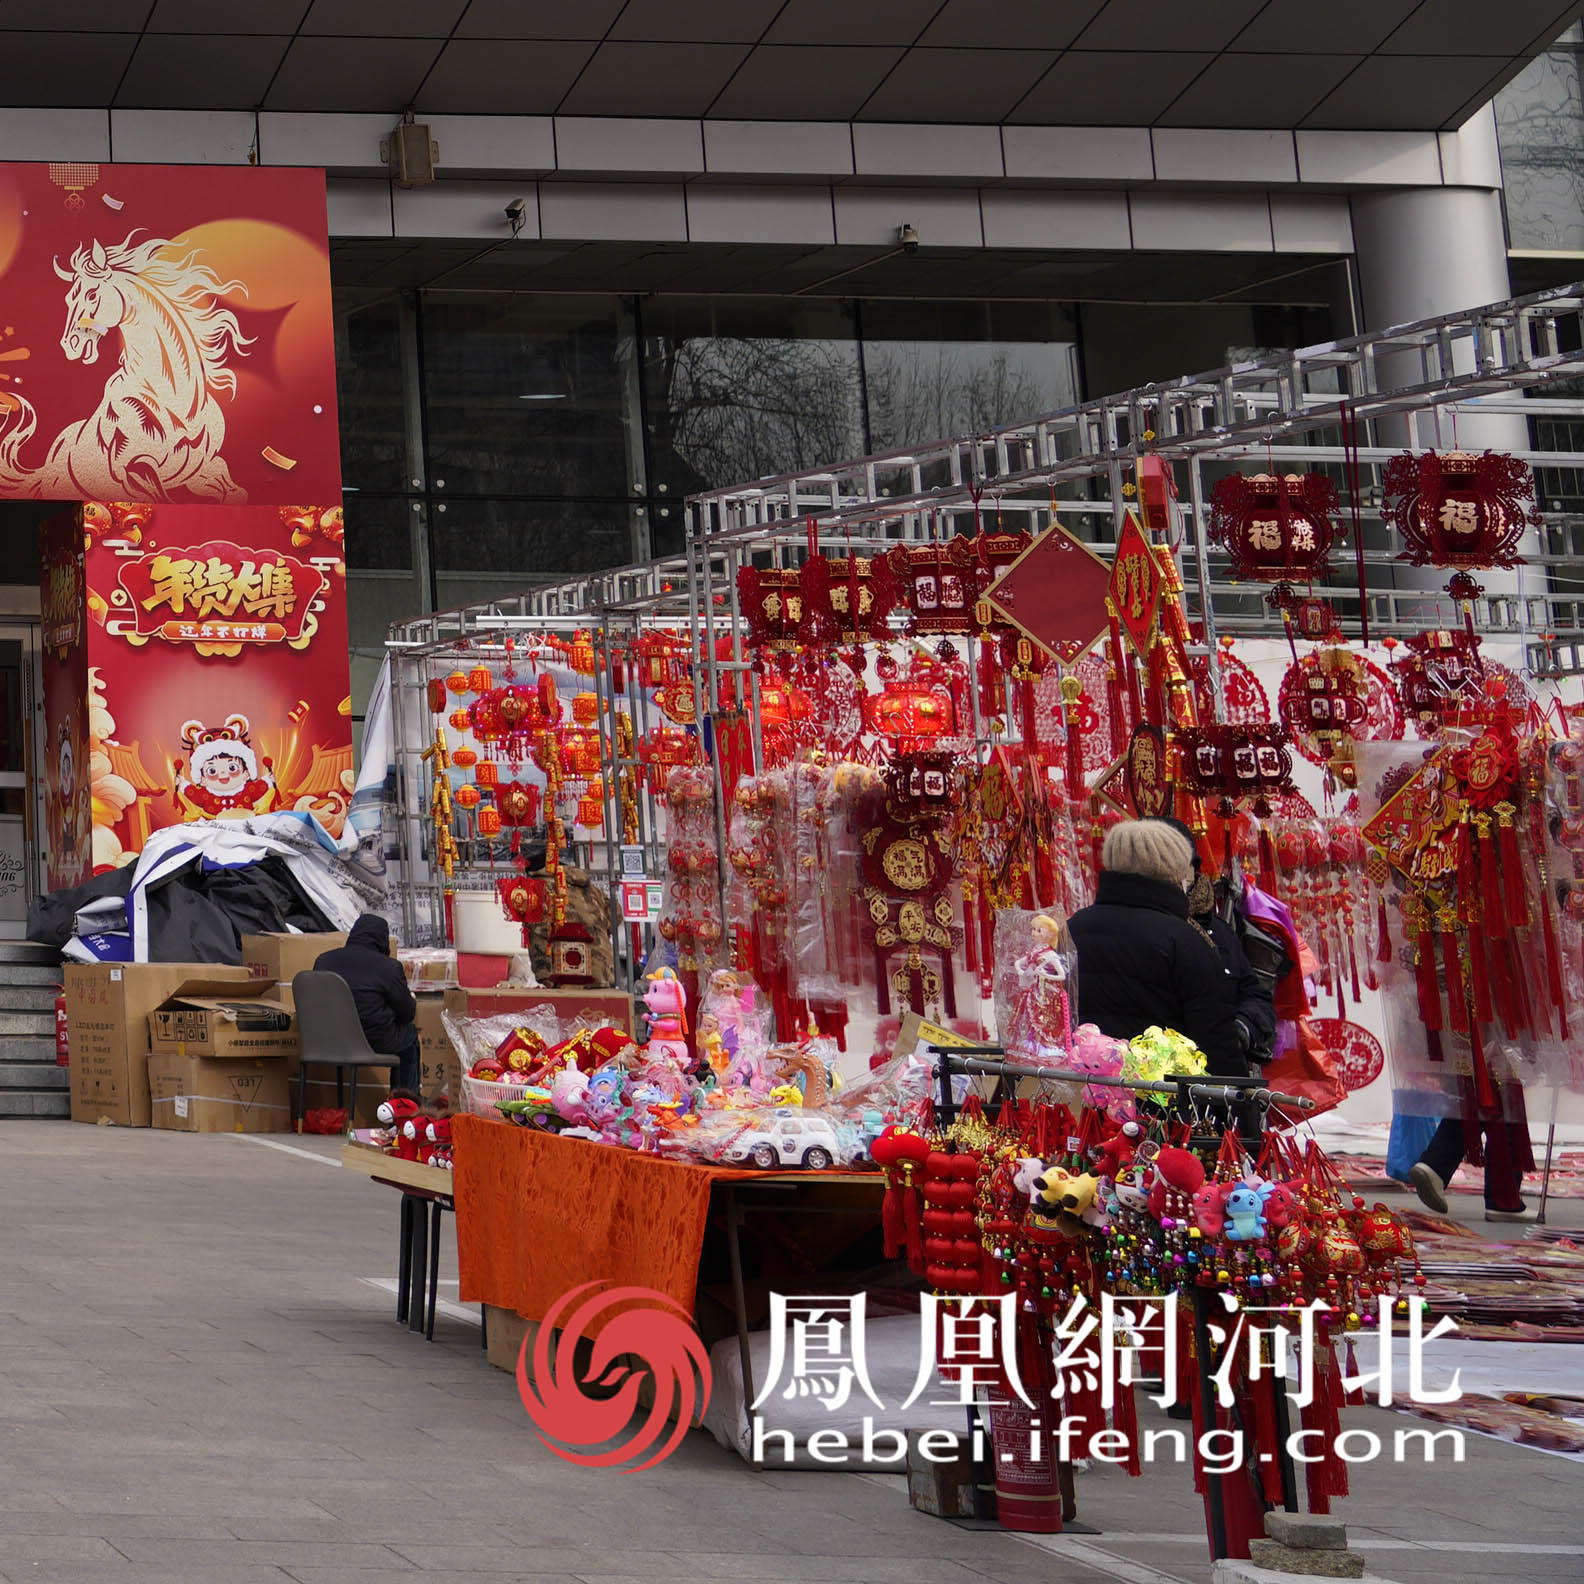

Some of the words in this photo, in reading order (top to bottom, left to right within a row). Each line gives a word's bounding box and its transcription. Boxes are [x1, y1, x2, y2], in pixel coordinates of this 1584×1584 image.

[1440, 499, 1479, 534] 福
[1248, 520, 1282, 551] 福
[140, 556, 298, 619] 年货大集
[178, 624, 268, 640] 过年不打烊
